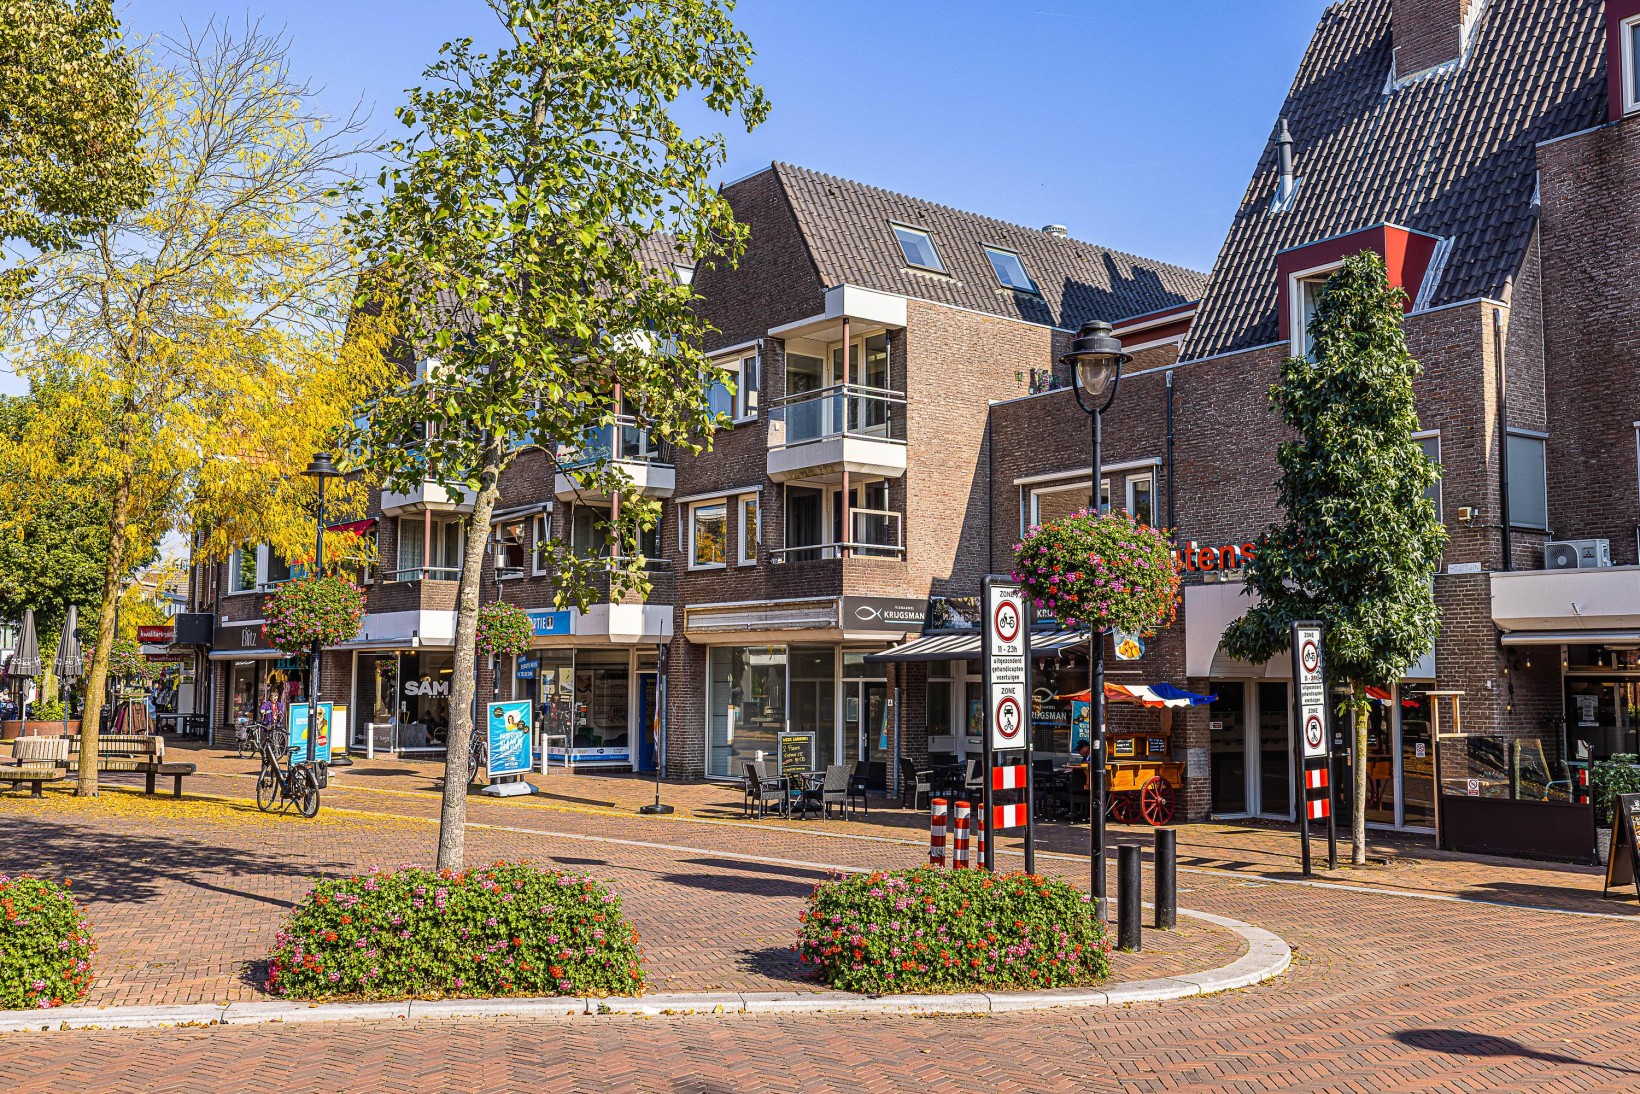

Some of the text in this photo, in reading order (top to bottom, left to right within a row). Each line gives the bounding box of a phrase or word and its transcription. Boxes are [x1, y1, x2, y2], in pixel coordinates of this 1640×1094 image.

[884, 610, 925, 620] KRIJGSMAN
[997, 645, 1003, 653] 11
[1007, 645, 1018, 653] 23h
[992, 666, 1024, 674] gehandicapten
[996, 674, 1020, 682] voertuigen
[404, 680, 449, 696] SAM
[1001, 687, 1016, 695] ZONE
